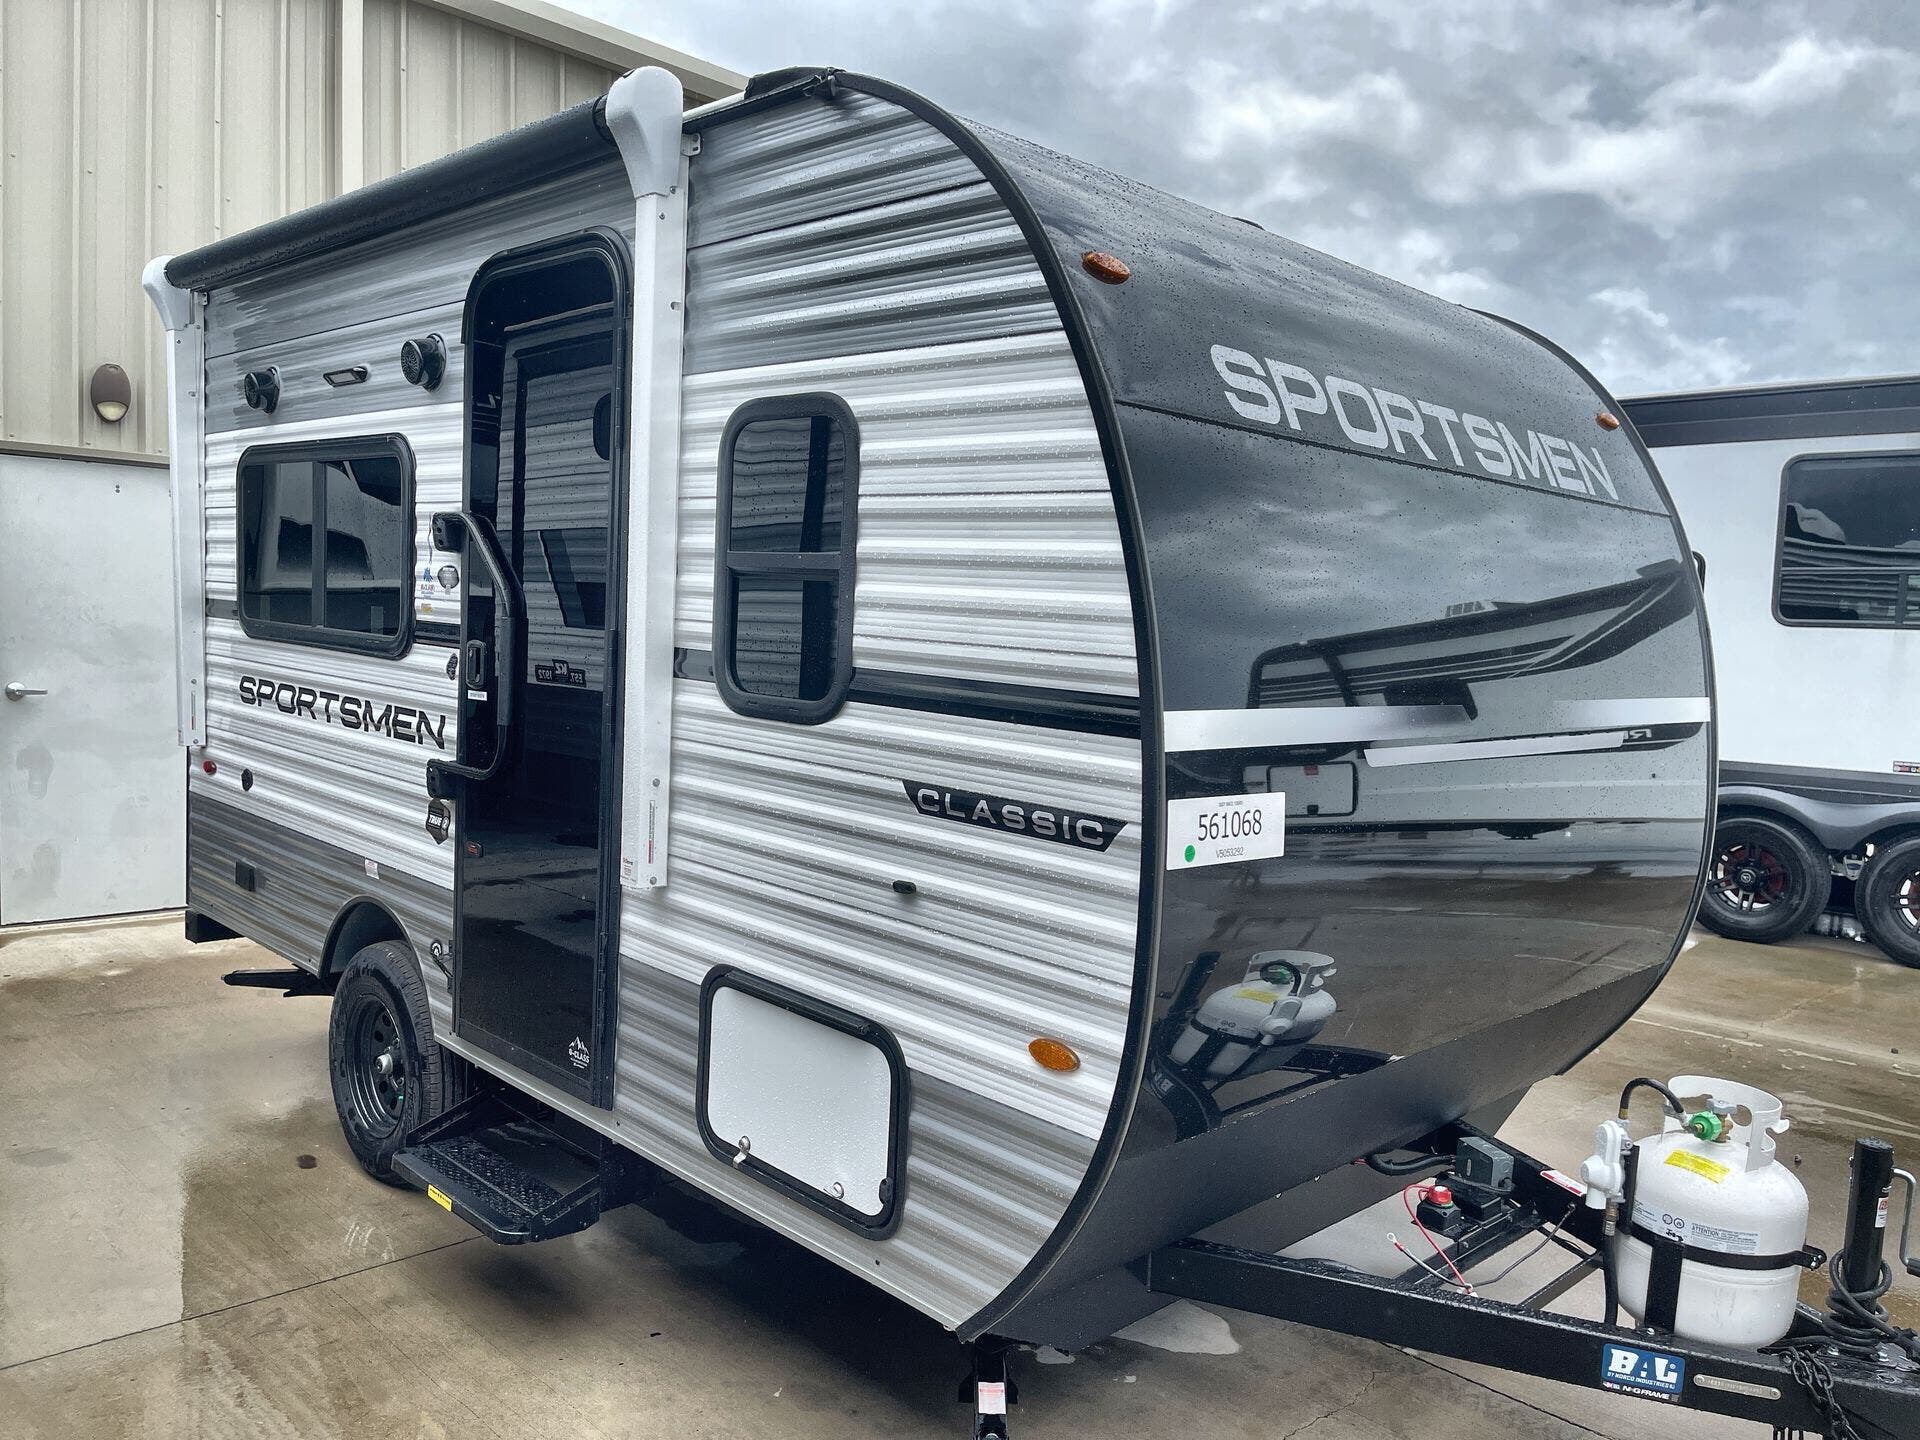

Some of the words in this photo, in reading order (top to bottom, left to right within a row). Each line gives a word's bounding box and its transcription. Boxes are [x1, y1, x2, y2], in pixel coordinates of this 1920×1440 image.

[1210, 344, 1619, 500] SPORTSMEN
[239, 675, 446, 750] SPORTSMEN
[917, 788, 1104, 845] CLASSIC
[1198, 809, 1262, 841] 561068
[1608, 1349, 1678, 1383] BAL
[1615, 1373, 1634, 1381] NORCO
[1636, 1377, 1670, 1388] INDUSTRIES
